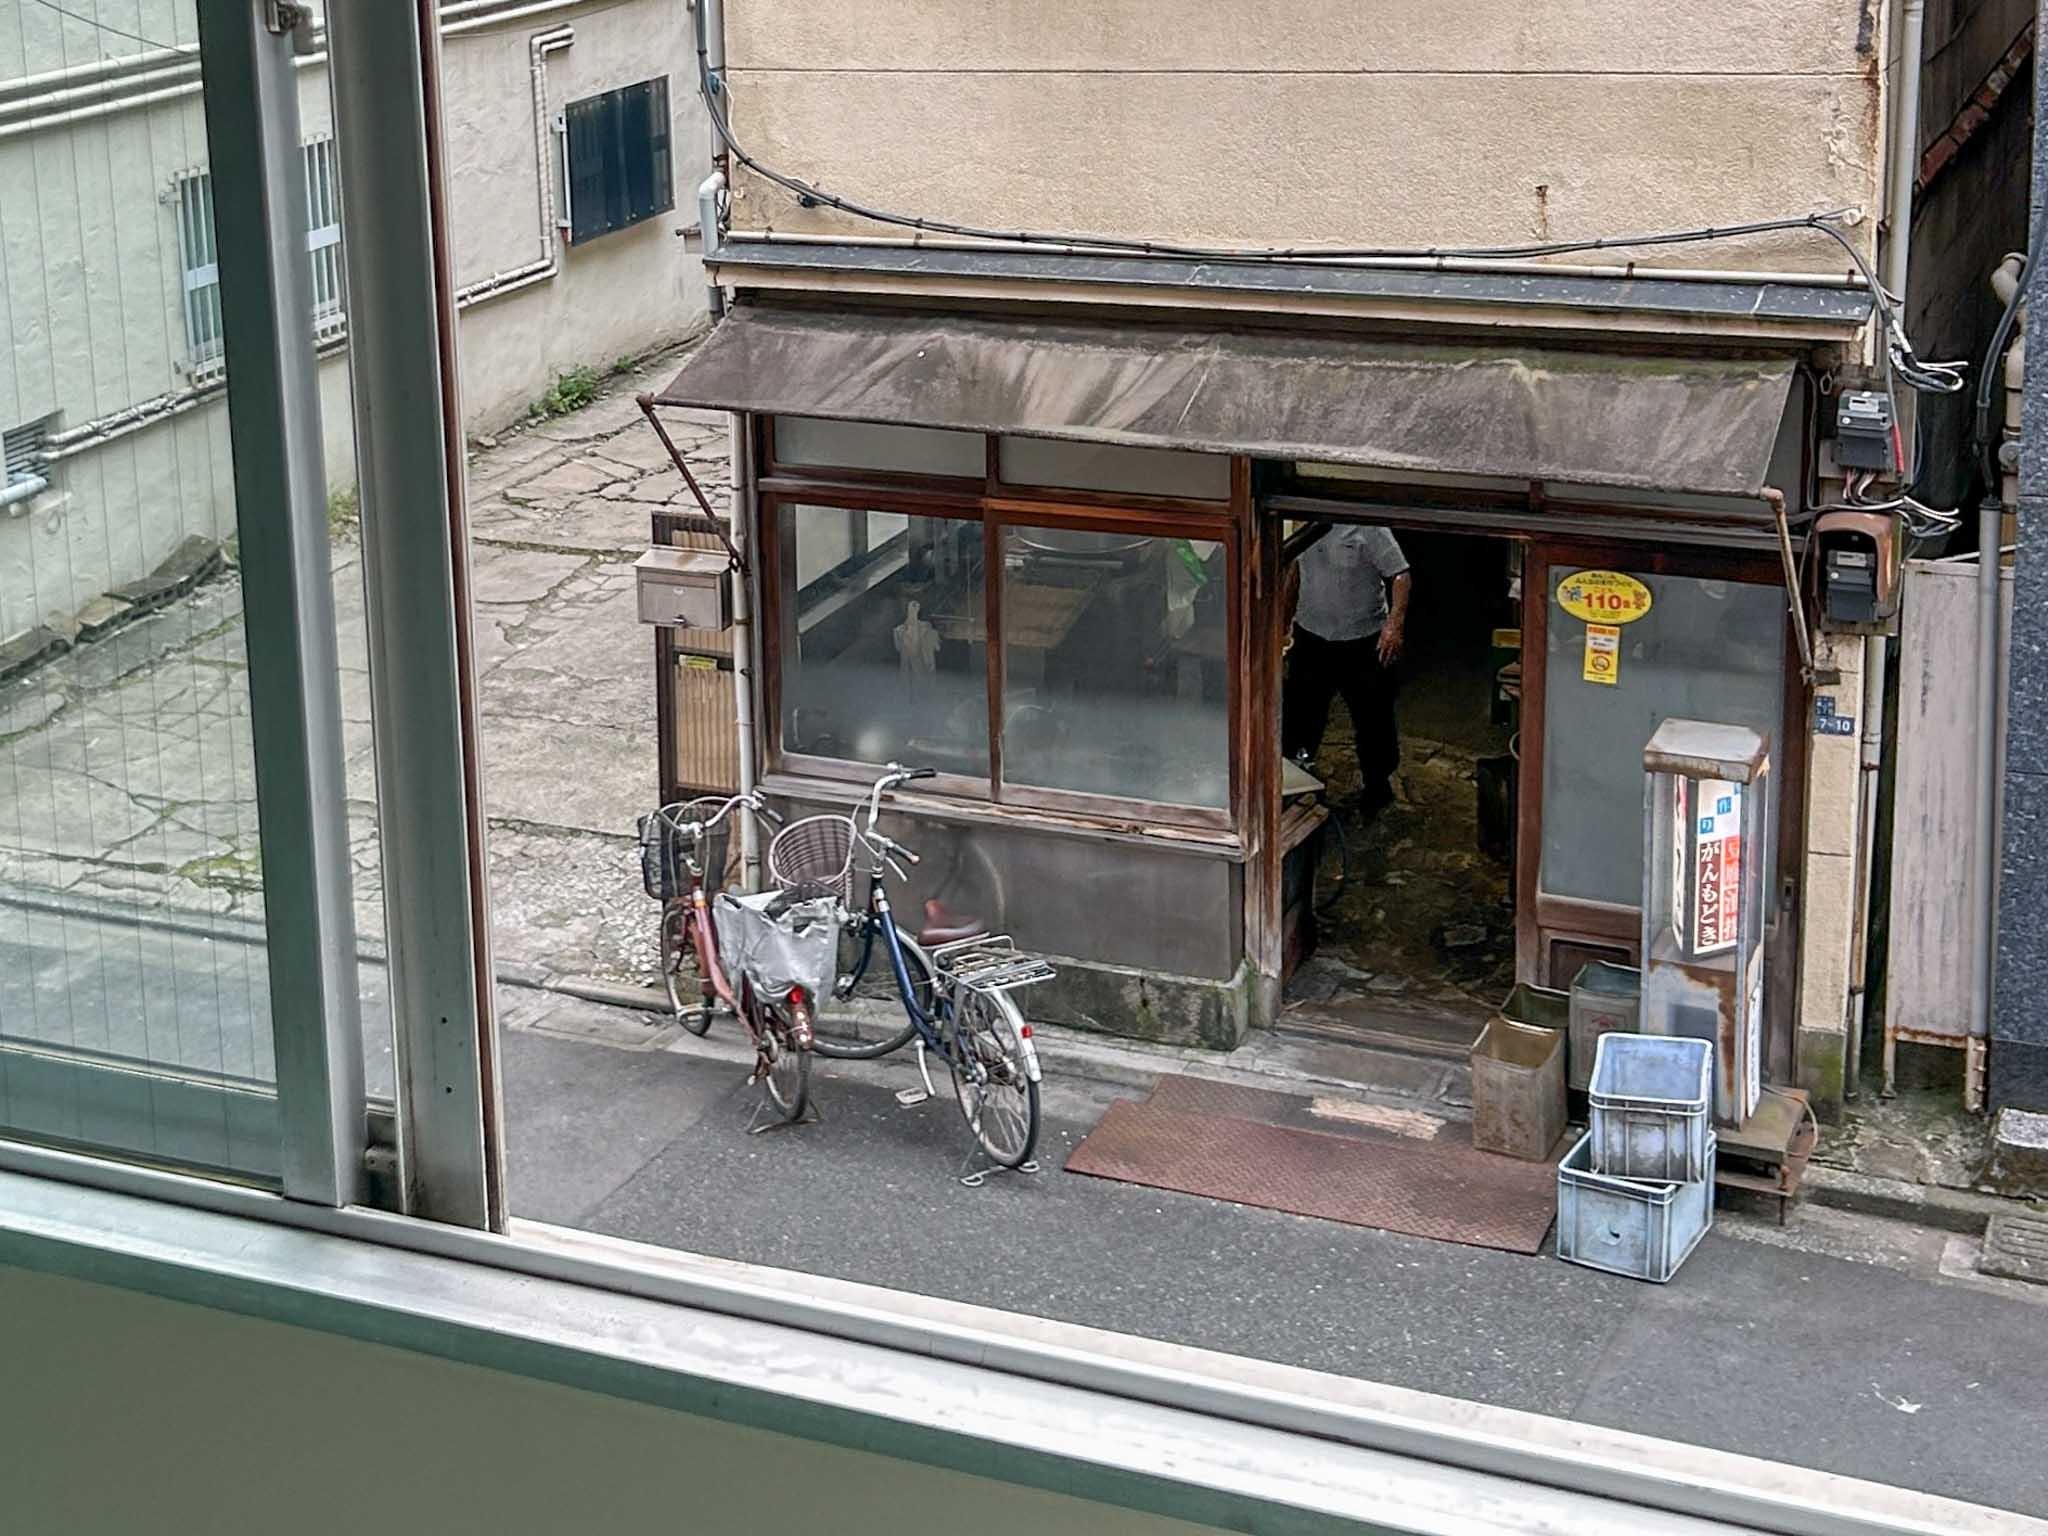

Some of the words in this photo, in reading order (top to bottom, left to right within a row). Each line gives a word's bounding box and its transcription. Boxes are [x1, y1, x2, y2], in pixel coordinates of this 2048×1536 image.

[1700, 842, 1721, 946] がんもどき
